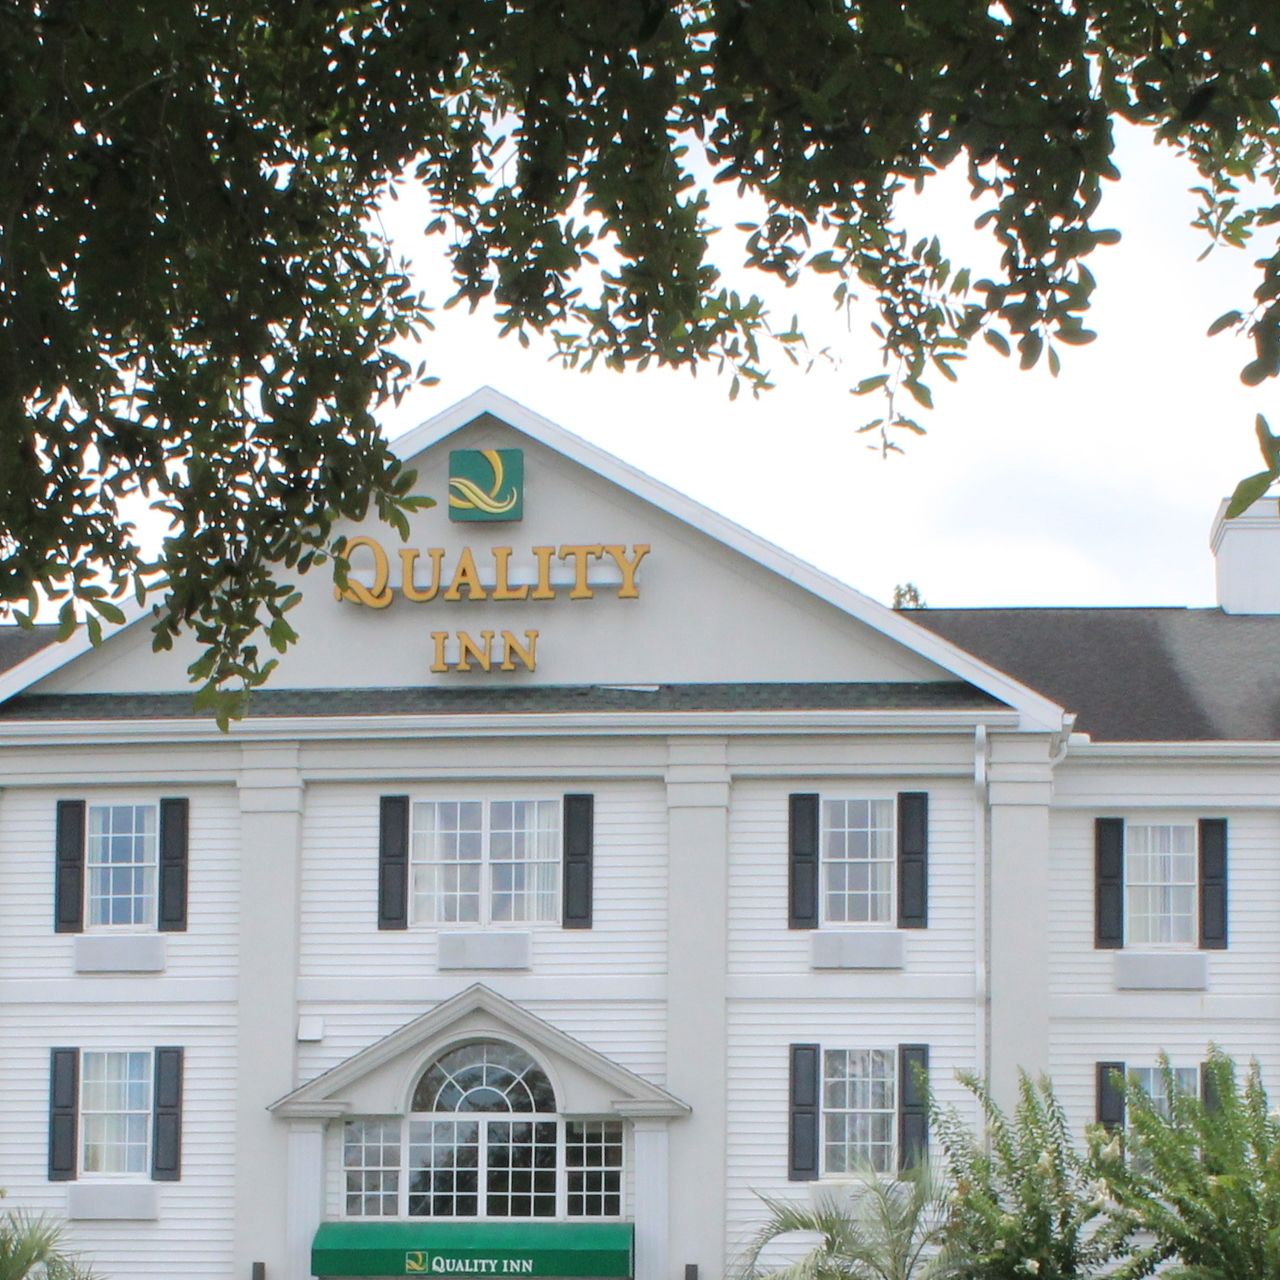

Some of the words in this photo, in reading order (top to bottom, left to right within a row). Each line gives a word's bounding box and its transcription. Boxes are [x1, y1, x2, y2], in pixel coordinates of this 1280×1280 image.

[334, 535, 651, 609] QUALITY
[430, 630, 539, 673] INN
[431, 1256, 498, 1273] QUALITY
[502, 1259, 533, 1273] INN
